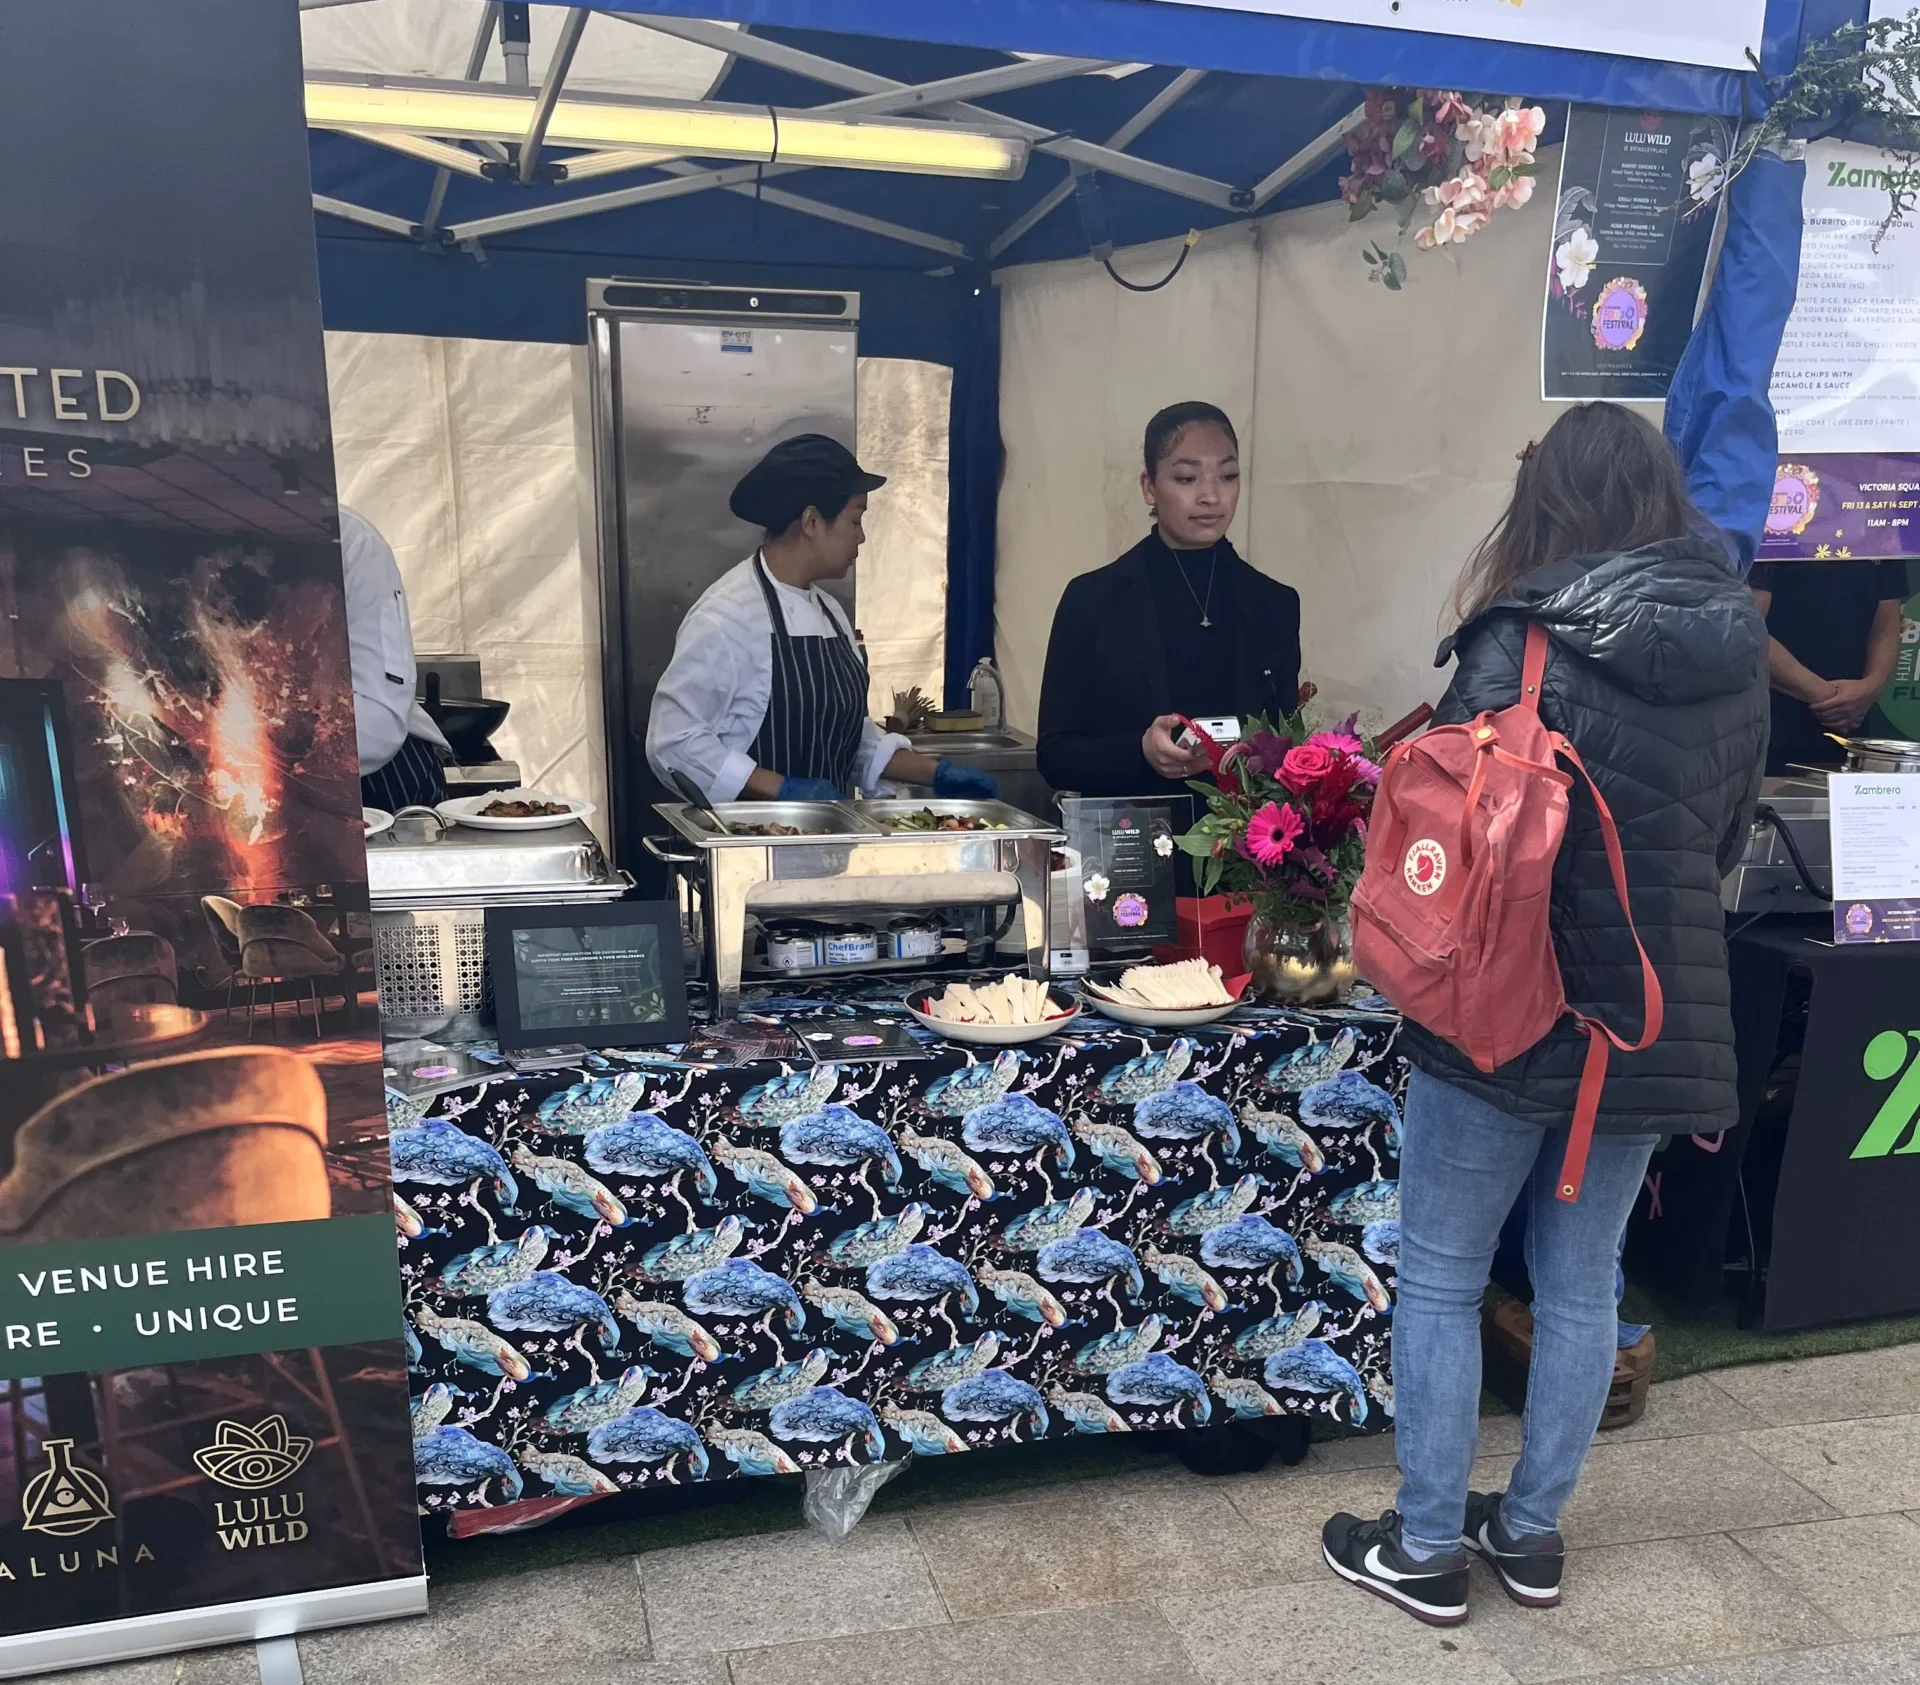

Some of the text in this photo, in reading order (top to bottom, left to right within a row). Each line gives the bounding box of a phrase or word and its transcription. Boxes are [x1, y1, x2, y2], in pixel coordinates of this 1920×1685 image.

[1624, 131, 1672, 146] LULU WILD
[1810, 218, 1847, 226] BURRITO
[1891, 220, 1915, 228] BOWL
[1602, 319, 1634, 330] FESTIVAL
[1859, 483, 1896, 491] VICTORIA
[1841, 501, 1855, 509] FRI
[1856, 501, 1864, 509] 13
[1871, 501, 1887, 509] SAT
[1898, 500, 1919, 508] SEPT
[1867, 518, 1887, 527] 11AM
[1891, 518, 1910, 527] 8PM
[1895, 648, 1913, 681] WITH
[1854, 784, 1901, 796] Zambrero
[828, 940, 875, 951] ChefBrand
[18, 1250, 285, 1297] VENUE HIRE
[5, 1297, 299, 1350] RE UNIQUE
[214, 1492, 304, 1527] LULU
[216, 1520, 309, 1551] WILD
